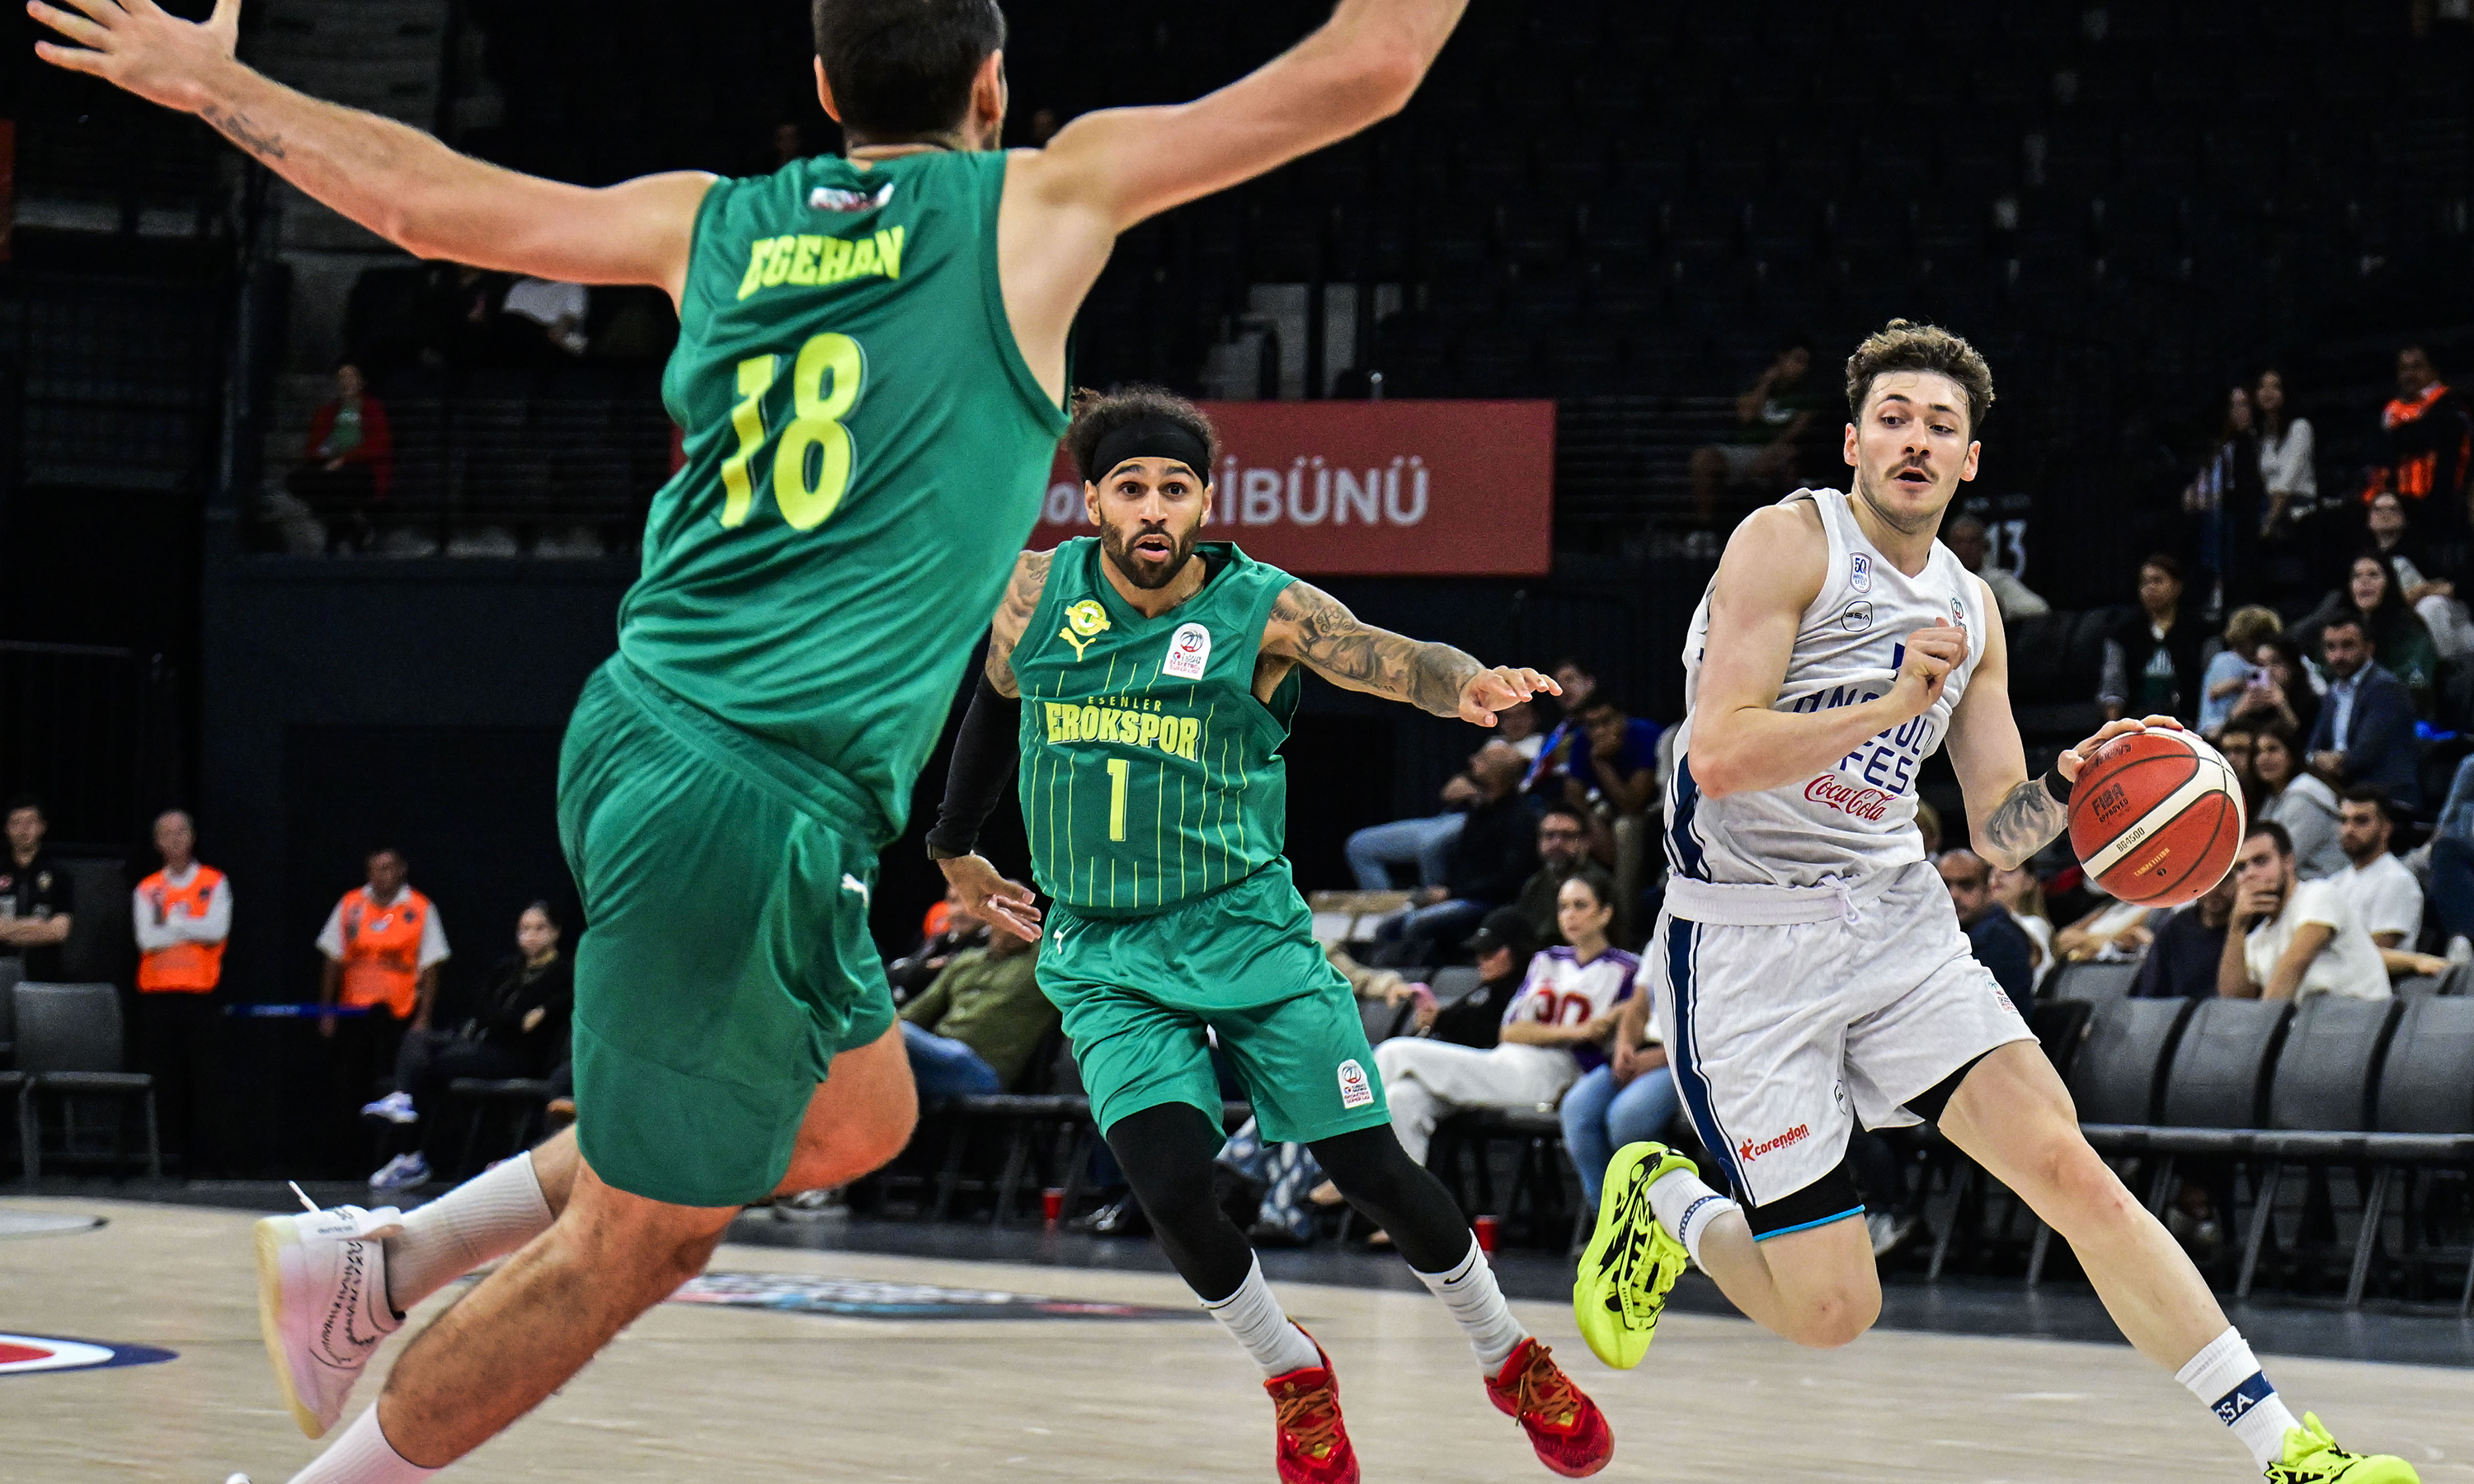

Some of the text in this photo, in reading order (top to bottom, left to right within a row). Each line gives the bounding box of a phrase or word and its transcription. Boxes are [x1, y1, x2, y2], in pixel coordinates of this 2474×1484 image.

[737, 225, 905, 300] EGEHAN
[720, 332, 868, 531] 18
[1846, 612, 1870, 622] GSA
[1088, 696, 1162, 712] ESENLER
[1045, 702, 1202, 762] EROKSPOR
[1837, 740, 1914, 796] FES
[1107, 758, 1129, 841] 1
[2091, 782, 2125, 816] FIBA
[2099, 798, 2128, 824] APPROVED
[2116, 826, 2146, 852] BG4500
[1755, 1124, 1809, 1156] corendon
